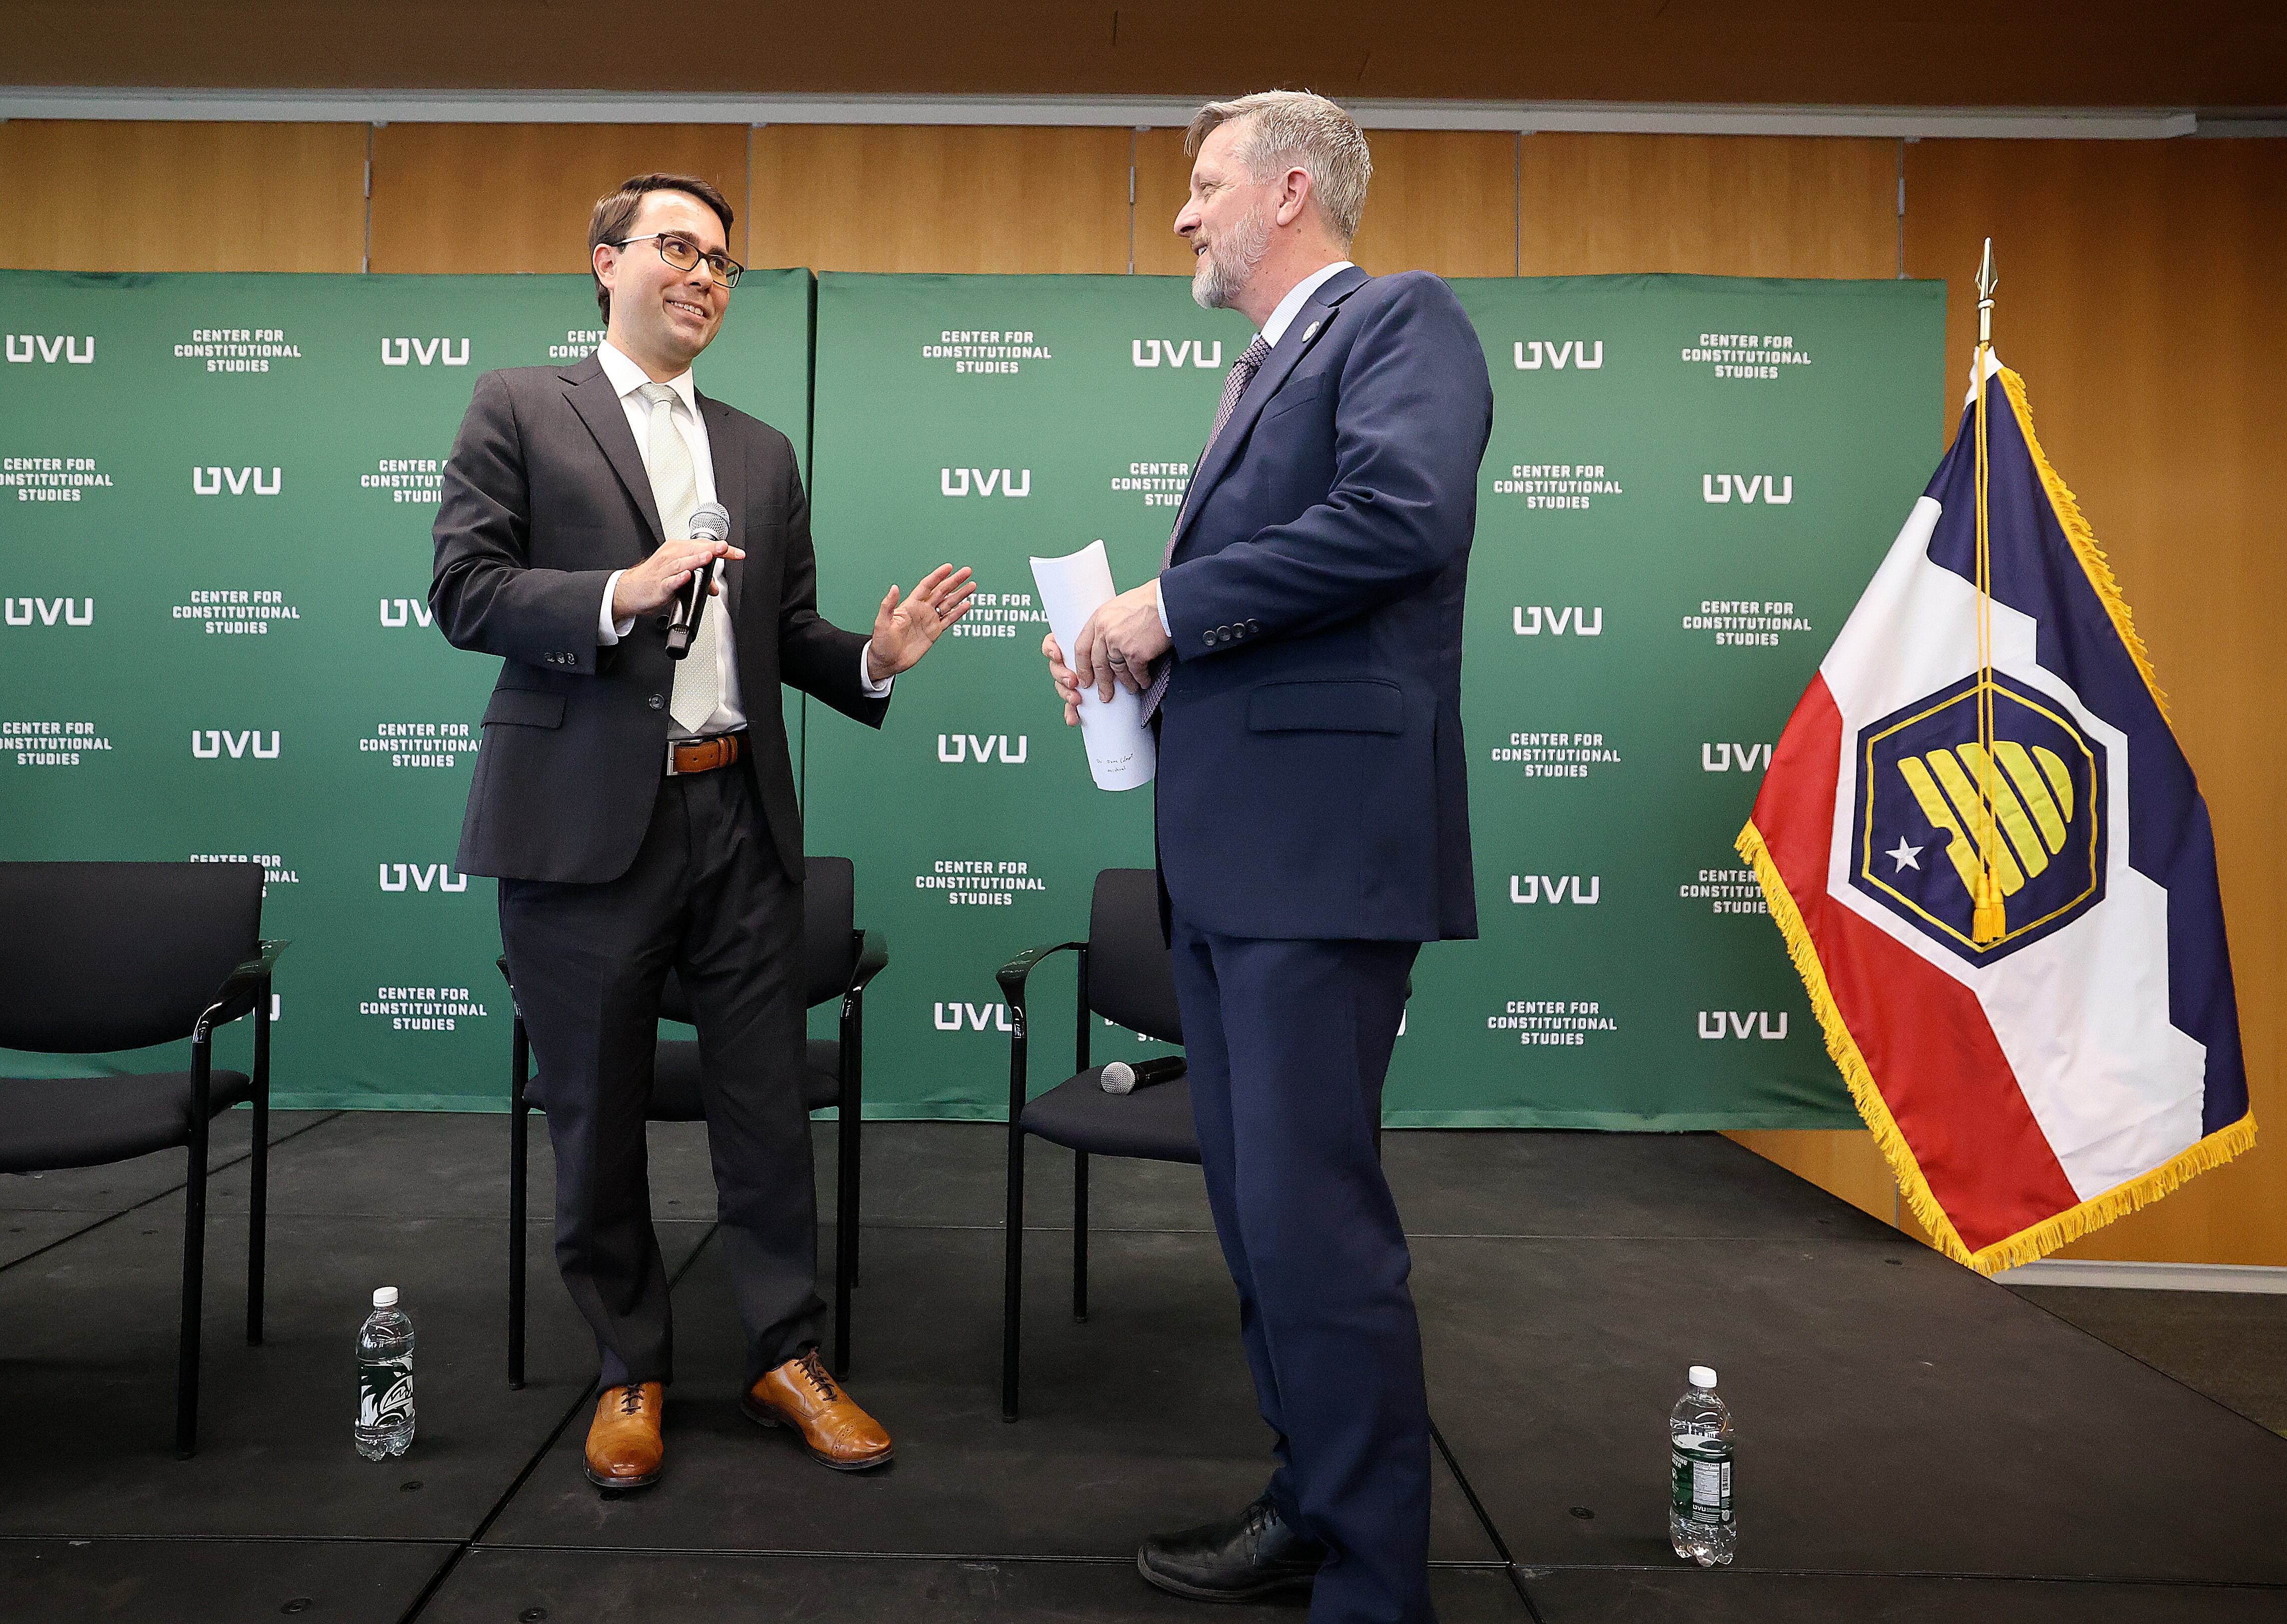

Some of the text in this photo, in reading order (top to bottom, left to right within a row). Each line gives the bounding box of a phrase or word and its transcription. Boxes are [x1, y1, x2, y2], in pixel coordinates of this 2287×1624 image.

[193, 329, 283, 343] CENTER FOR
[567, 330, 605, 343] CENT
[941, 331, 1034, 344] CENTER FOR
[1700, 334, 1793, 349] CENTER FOR
[6, 335, 95, 364] UVU
[174, 344, 301, 358] CONSTITUTIONAL
[382, 338, 470, 366] UVU
[922, 346, 1052, 359] CONSTITUTIONAL
[1132, 340, 1221, 369] UVU
[1513, 341, 1603, 370] UVU
[1682, 348, 1812, 365] CONSTITUTIONAL
[207, 359, 269, 373] STUDIES
[956, 361, 1019, 374] STUDIES
[1715, 365, 1778, 380] STUDIES
[4, 458, 96, 471] CENTER FOR
[379, 460, 437, 472] CENTER
[1130, 462, 1189, 475] CENTER
[1512, 465, 1604, 478] CENTER FOR
[0, 473, 114, 487] ONSTITUTIONAL
[193, 467, 281, 495] UVU
[361, 475, 445, 488] CONSTITUT
[941, 468, 1031, 497] UVU
[1111, 478, 1190, 491] CONSTITU
[1493, 480, 1623, 494] CONSTITUTIONAL
[18, 488, 81, 501] STUDIES
[1703, 474, 1792, 504] UVU
[393, 490, 442, 503] STUDI
[1144, 493, 1183, 507] STUD
[1527, 496, 1589, 509] STUDIES
[191, 590, 282, 604] CENTER FOR
[1002, 594, 1031, 606] FOR
[5, 597, 94, 626] UVU
[173, 605, 300, 619] CONSTITUTIONAL
[380, 599, 433, 627] UV
[1701, 600, 1793, 615] CENTER FOR
[961, 609, 1049, 622] TITUTIONAL
[1513, 606, 1602, 636] UVU
[205, 621, 267, 634] STUDIES
[953, 624, 1016, 637] STUDIES
[1682, 616, 1812, 631] CONSTITUTIONAL
[1716, 632, 1779, 646] STUDIES
[3, 722, 94, 735] CENTER FOR
[378, 723, 469, 737] CENTER FOR
[0, 737, 113, 750] NSTITUTIONAL
[192, 730, 280, 759] UVU
[359, 739, 482, 752] CONSTITUTIONA
[1510, 733, 1602, 747] CENTER FOR
[937, 734, 1027, 763] UVU
[1491, 748, 1621, 763] CONSTITUTIONAL
[17, 753, 80, 766] STUDIES
[392, 754, 454, 767] STUDIES
[1526, 764, 1587, 778] STUDIES
[252, 854, 281, 867] FOR
[934, 861, 1027, 874] CENTER FOR
[380, 863, 467, 892] UVU
[1699, 869, 1757, 882] CENTER
[916, 876, 1046, 890] CONSTITUTIONAL
[1510, 875, 1599, 904] UVU
[1680, 884, 1764, 898] CONSTITUT
[949, 892, 1012, 905] STUDIES
[1713, 901, 1771, 914] STUDIE
[378, 987, 469, 1001] CENTER FOR
[360, 1002, 487, 1016] CONSTITUTIONAL
[1506, 1001, 1599, 1014] CENTER FOR
[393, 1018, 455, 1031] STUDIES
[1487, 1016, 1617, 1030] CONSTITUTIONAL
[1698, 1011, 1788, 1040] UVU
[1520, 1032, 1584, 1045] STUDIES
